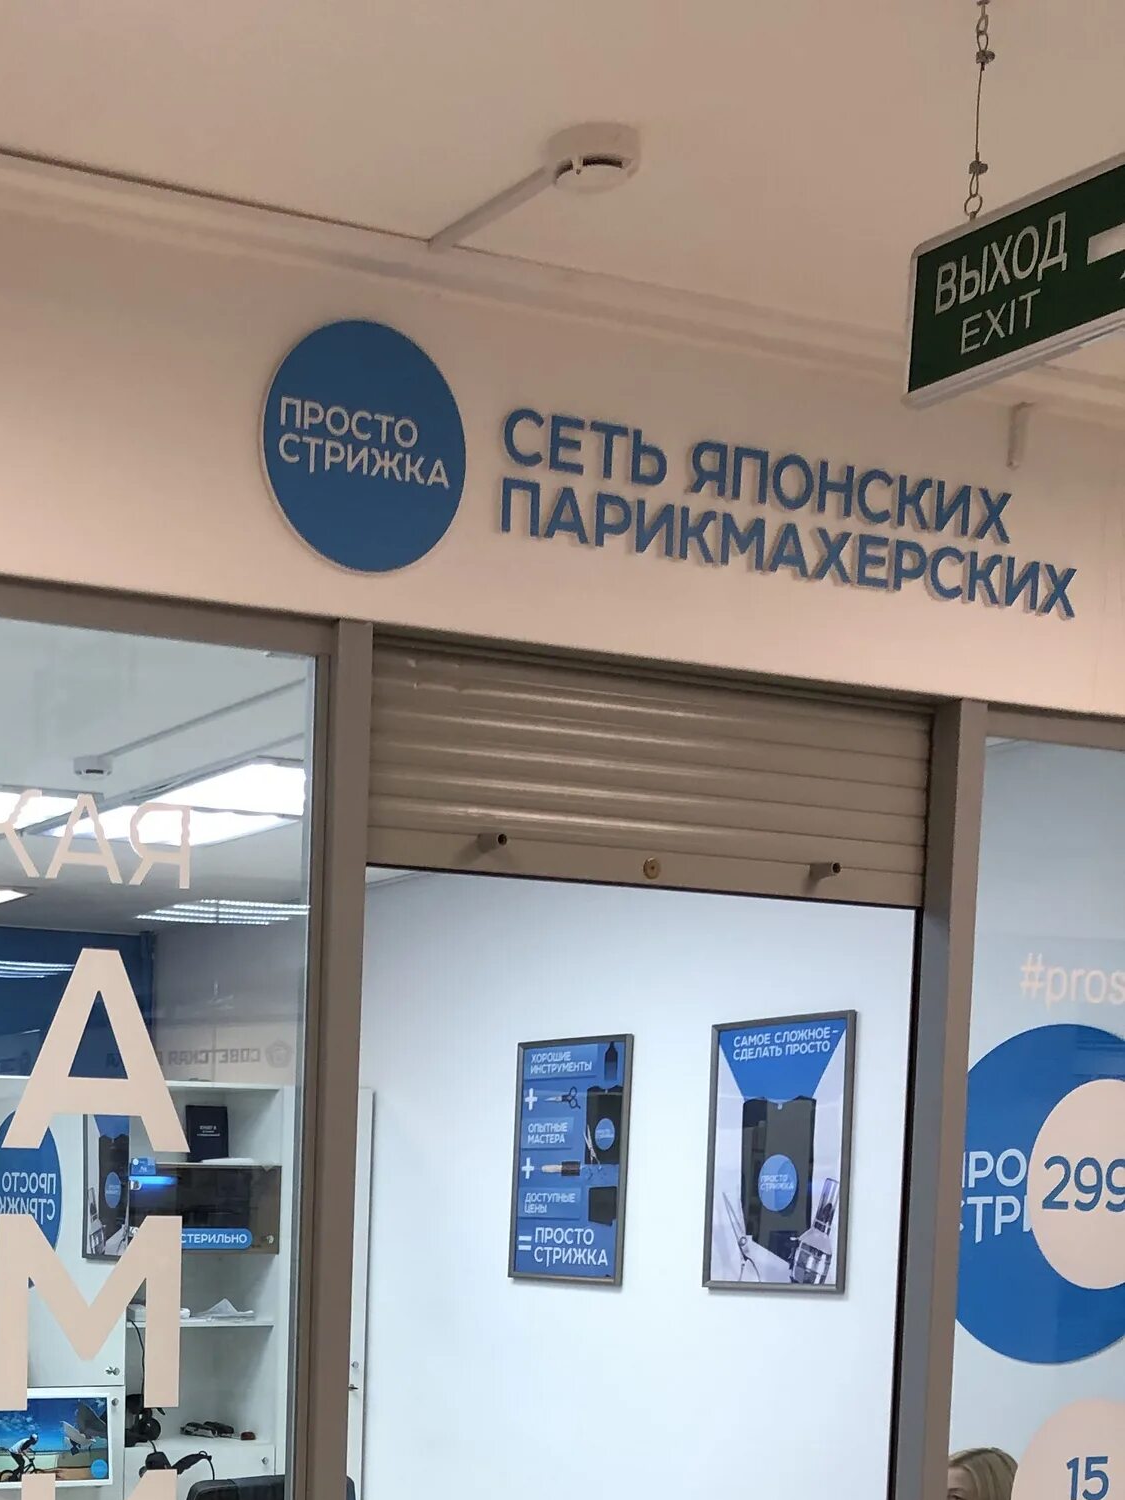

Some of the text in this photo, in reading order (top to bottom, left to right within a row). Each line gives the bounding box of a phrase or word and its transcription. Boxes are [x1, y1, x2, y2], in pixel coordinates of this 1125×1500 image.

[934, 212, 1068, 315] ВЫХОД
[960, 289, 1041, 355] EXIT
[279, 396, 418, 449] ПРОСТО
[279, 432, 451, 491] СТРИЖКА
[503, 408, 1012, 544] СЕТЬ ЯПОНСКИХ
[501, 477, 1077, 620] ПАРИКМАХЕРСКИХ
[733, 1033, 772, 1048] САМОЕ
[531, 1051, 572, 1064] ХОРОШИЕ
[733, 1040, 831, 1061] СДЕЛАТЬ ПРОСТО
[530, 1061, 593, 1074] ИНСТРУМЕНТЫ
[528, 1122, 568, 1133] ОПЫТНЫЕ
[528, 1133, 565, 1144] МАСТЕРА
[525, 1192, 576, 1203] ДОСТУПНЫЕ
[524, 1203, 548, 1214] ЦЕНЫ
[181, 1233, 248, 1244] СТЕРИЛЬНО
[535, 1227, 594, 1246] ПРОСТО
[534, 1246, 609, 1268] СТРИЖКА
